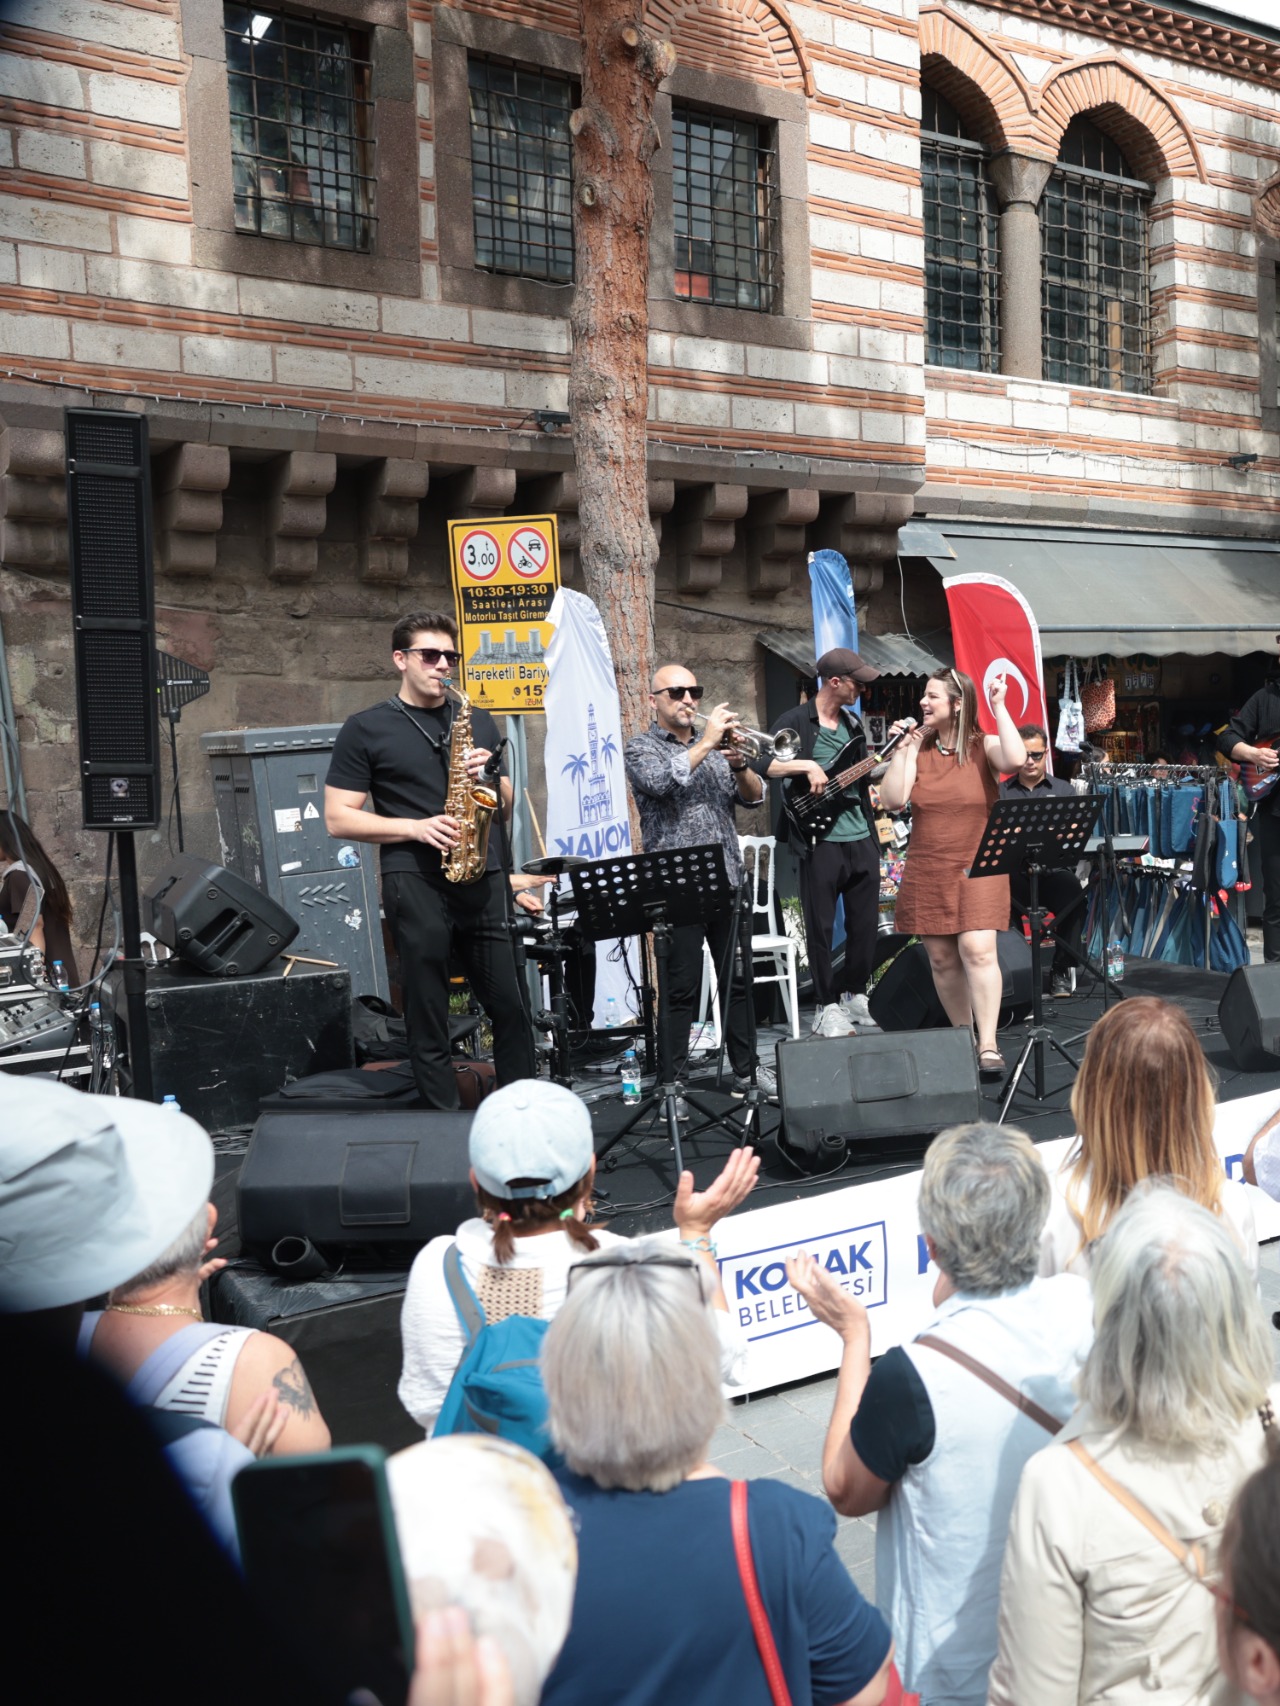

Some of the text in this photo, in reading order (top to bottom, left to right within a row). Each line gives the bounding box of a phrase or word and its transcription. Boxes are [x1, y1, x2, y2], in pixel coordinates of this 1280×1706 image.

[467, 584, 548, 598] 10:30-19:30
[518, 598, 547, 608] Arası
[465, 610, 549, 622] Motorlu Taşıt Gireme
[467, 665, 549, 683] Hareketli Bariy
[523, 684, 548, 696] 15
